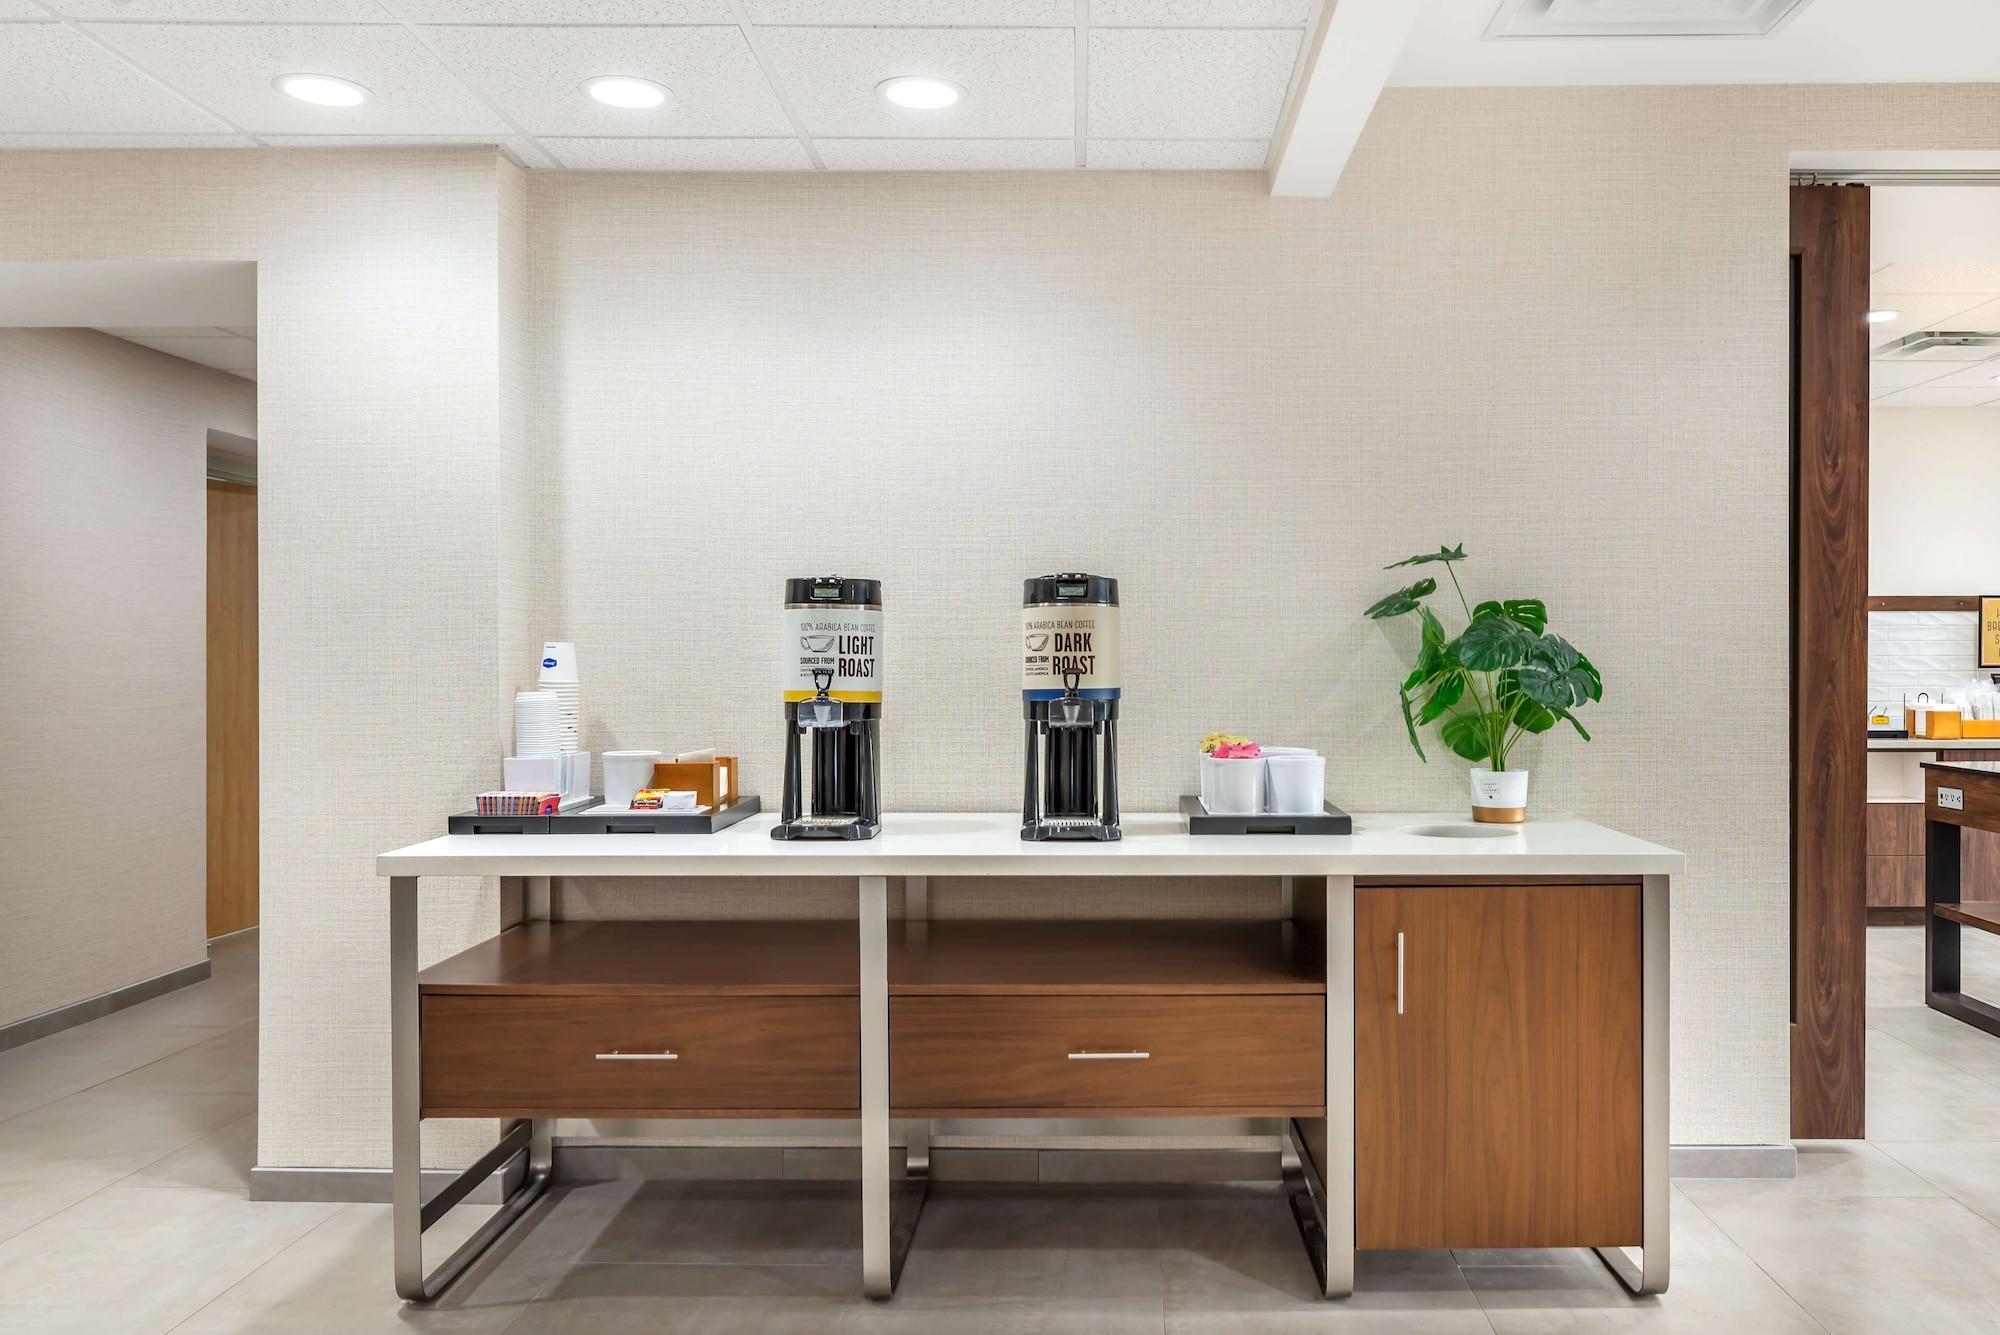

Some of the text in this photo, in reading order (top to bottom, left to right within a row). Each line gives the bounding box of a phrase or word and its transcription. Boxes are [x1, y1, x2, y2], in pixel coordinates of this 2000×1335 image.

[800, 623, 814, 631] 100%
[815, 623, 841, 631] ARABICA
[844, 624, 858, 632] BEAN
[1057, 620, 1073, 629] BEAN
[839, 635, 874, 655] LIGHT
[1055, 632, 1092, 652] DARK
[839, 658, 875, 677] ROAST
[1052, 655, 1095, 675] ROAST
